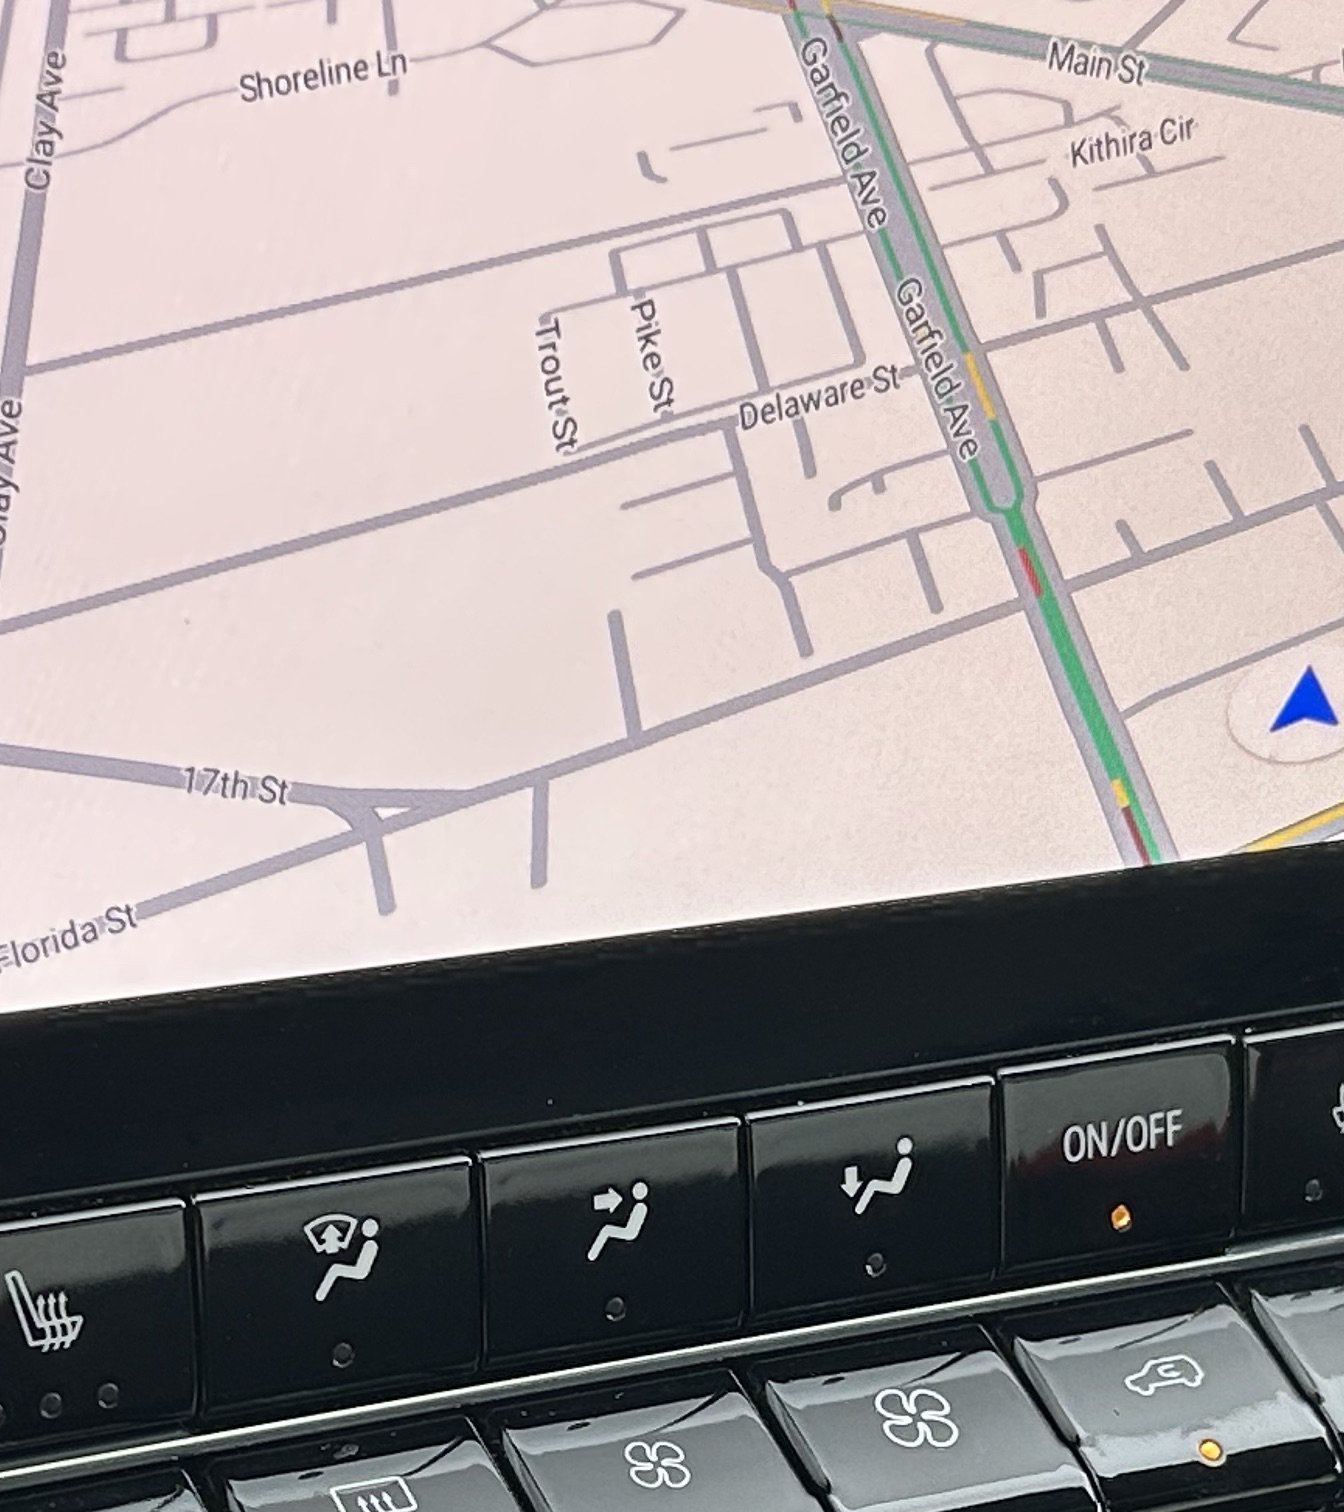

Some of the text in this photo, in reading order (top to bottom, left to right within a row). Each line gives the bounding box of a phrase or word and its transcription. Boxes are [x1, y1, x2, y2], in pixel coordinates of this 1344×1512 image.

[239, 51, 408, 102] Shoreline Ln
[1048, 41, 1146, 86] Main St
[24, 51, 66, 190] Clay Ave
[801, 37, 887, 229] Garfield Ave
[1070, 117, 1196, 168] Kithira Cir
[535, 318, 579, 452] Trout St
[630, 299, 675, 412] Pike St
[897, 277, 978, 461] Garfield Ave
[739, 364, 900, 431] Delaware St
[185, 766, 288, 805] 17th St
[105, 904, 138, 935] St
[1063, 1108, 1183, 1163] ON/OFF
